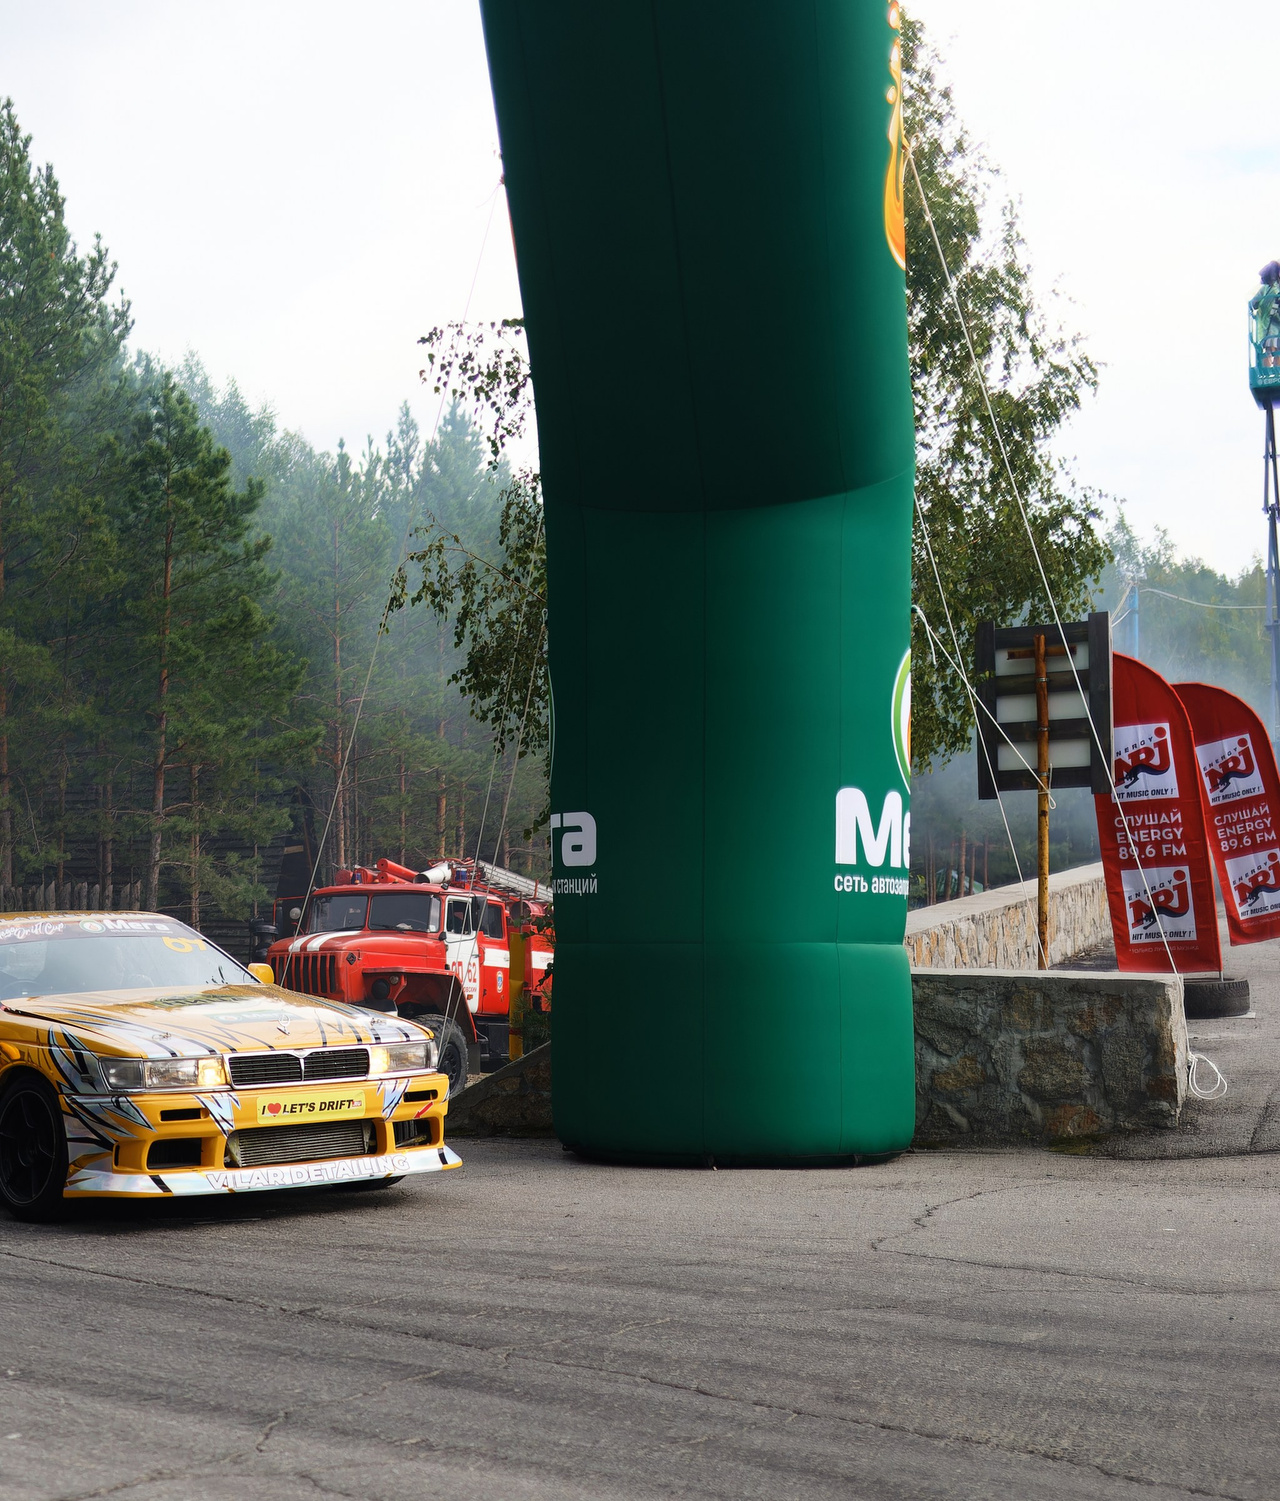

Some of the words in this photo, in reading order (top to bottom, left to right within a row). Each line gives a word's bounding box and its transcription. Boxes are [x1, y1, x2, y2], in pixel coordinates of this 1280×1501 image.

[1115, 736, 1153, 757] NERGY
[1126, 789, 1149, 798] MUSIC
[1151, 788, 1169, 796] ONLY
[1211, 795, 1221, 803] HIT
[1222, 791, 1241, 800] MUSIC
[1241, 787, 1256, 796] ONLY
[1114, 808, 1182, 828] СЛУШАЙ
[1214, 802, 1270, 826] СЛУШАЙ
[835, 787, 910, 869] М
[1116, 827, 1184, 844] ENERGY
[1217, 817, 1272, 839] ENERGY
[1220, 835, 1252, 852] 89.6
[1256, 829, 1277, 844] FM
[1118, 844, 1156, 860] 89.6
[1162, 843, 1187, 857] FM
[557, 873, 598, 897] станций
[834, 875, 868, 893] сеть
[1250, 905, 1269, 915] MUSIC
[1144, 931, 1168, 939] MUSIC
[1169, 930, 1187, 938] ONLY
[282, 1102, 316, 1114] LET'S
[319, 1099, 354, 1112] DRIFT
[205, 1168, 287, 1191] VILAR
[289, 1155, 411, 1184] DETAILING
